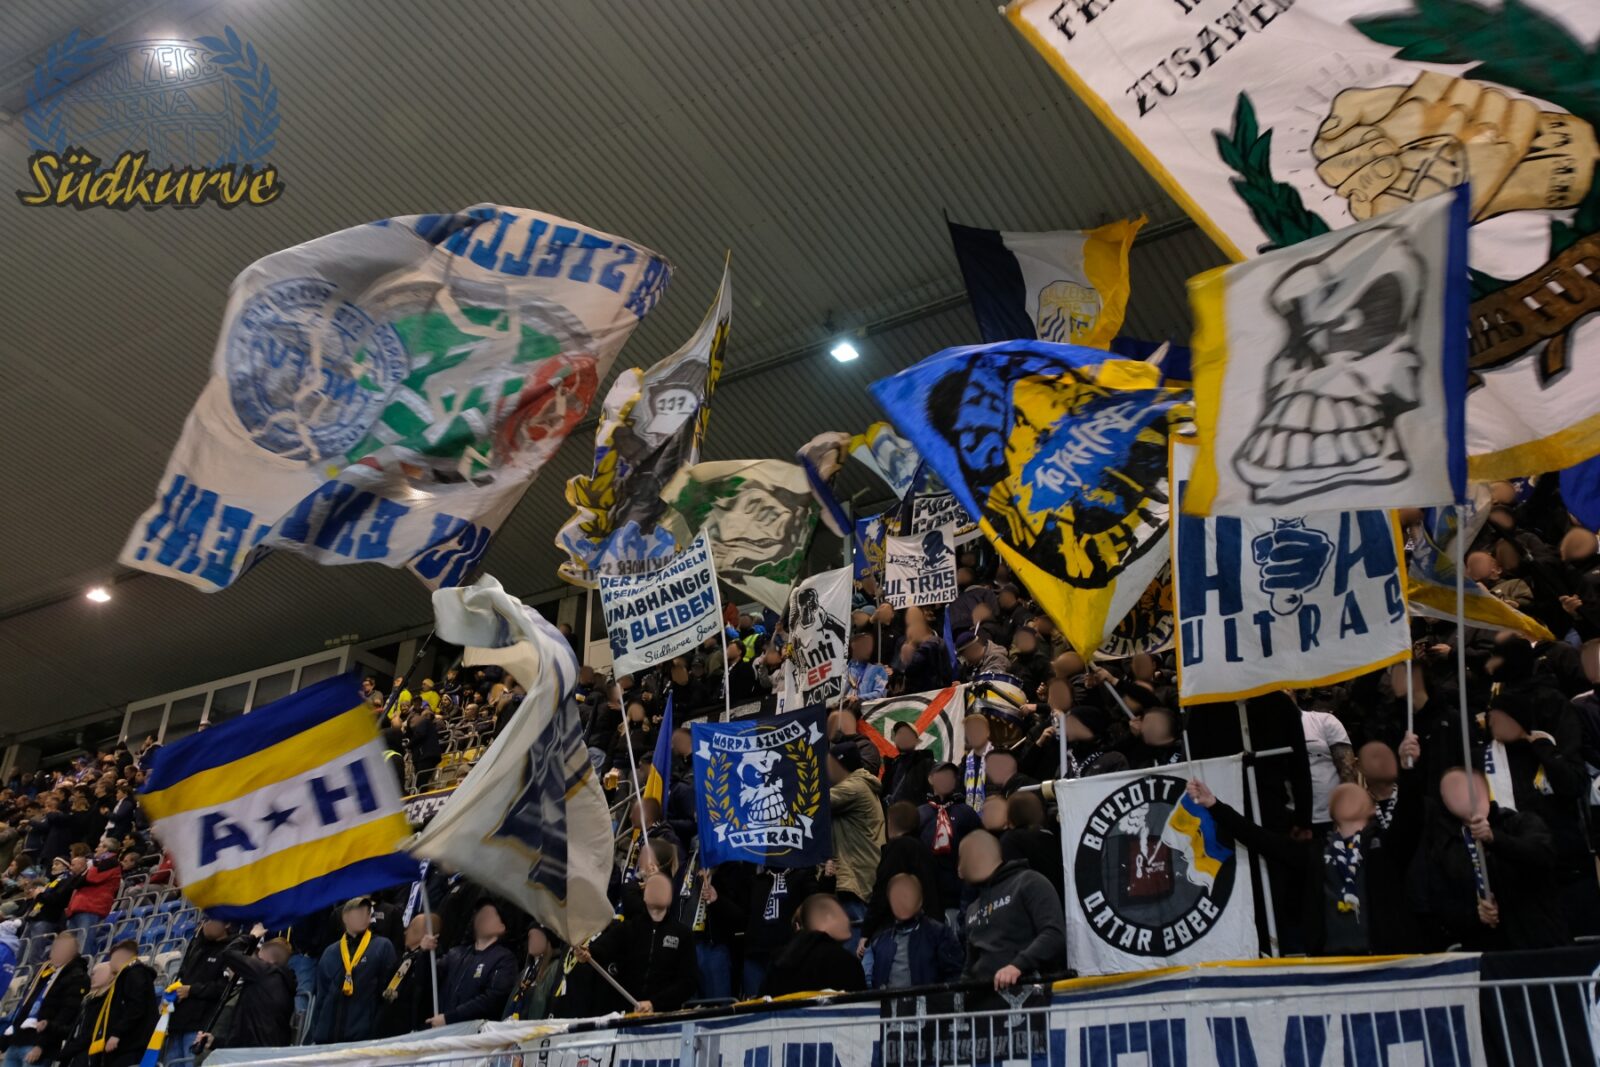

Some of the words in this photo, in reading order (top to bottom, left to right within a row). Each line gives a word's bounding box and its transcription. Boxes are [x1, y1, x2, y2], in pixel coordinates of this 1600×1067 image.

[1049, 0, 1114, 41] FR
[1065, 401, 1150, 487] JAHRE
[600, 574, 634, 588] DER
[606, 568, 711, 628] UNABHÄNGIG
[885, 570, 956, 596] ULTRAS
[912, 588, 958, 604] IMMER
[630, 587, 715, 643] BLEIBEN
[696, 620, 718, 642] Jena
[1102, 613, 1174, 656] EIMAR
[1181, 573, 1406, 668] ULTRAS
[805, 677, 842, 708] ACTION
[807, 661, 833, 686] EF
[756, 722, 802, 749] AZZURO
[198, 811, 258, 869] A
[308, 757, 379, 827] H
[1082, 778, 1175, 851] BOYCOTT
[730, 828, 801, 845] ULTRAS
[1083, 889, 1153, 951] QATAR
[1162, 896, 1220, 951] 2022
